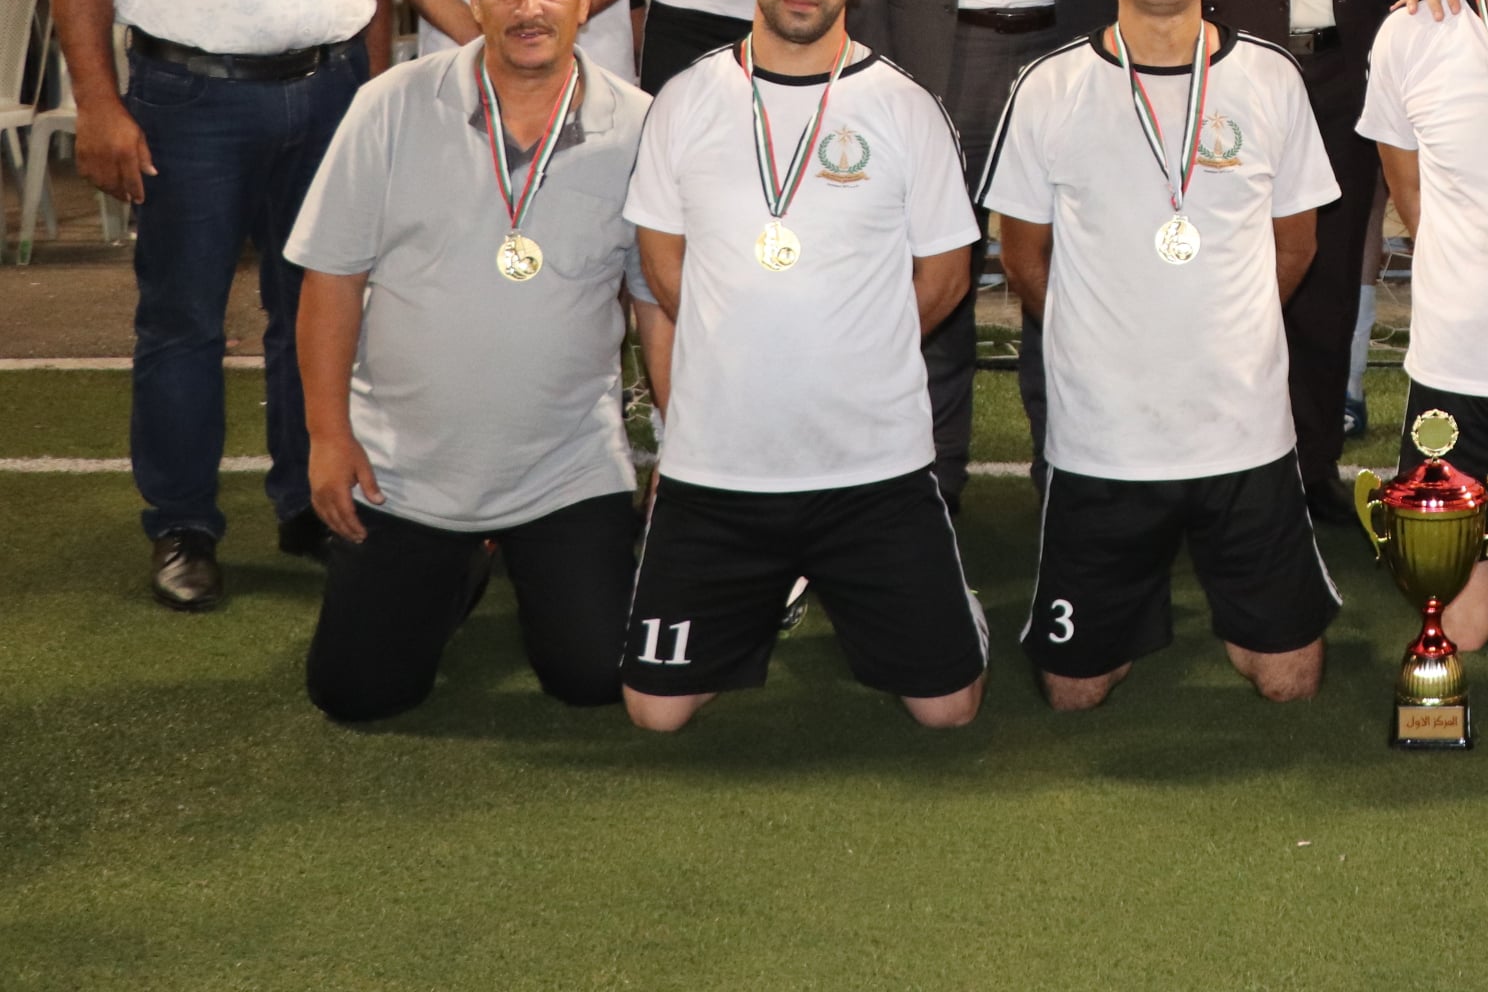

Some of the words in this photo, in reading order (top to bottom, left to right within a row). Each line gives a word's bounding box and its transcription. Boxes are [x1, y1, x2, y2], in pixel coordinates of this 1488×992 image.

[637, 618, 692, 665] 11
[1048, 598, 1075, 643] 3
[1433, 715, 1458, 729] المركز
